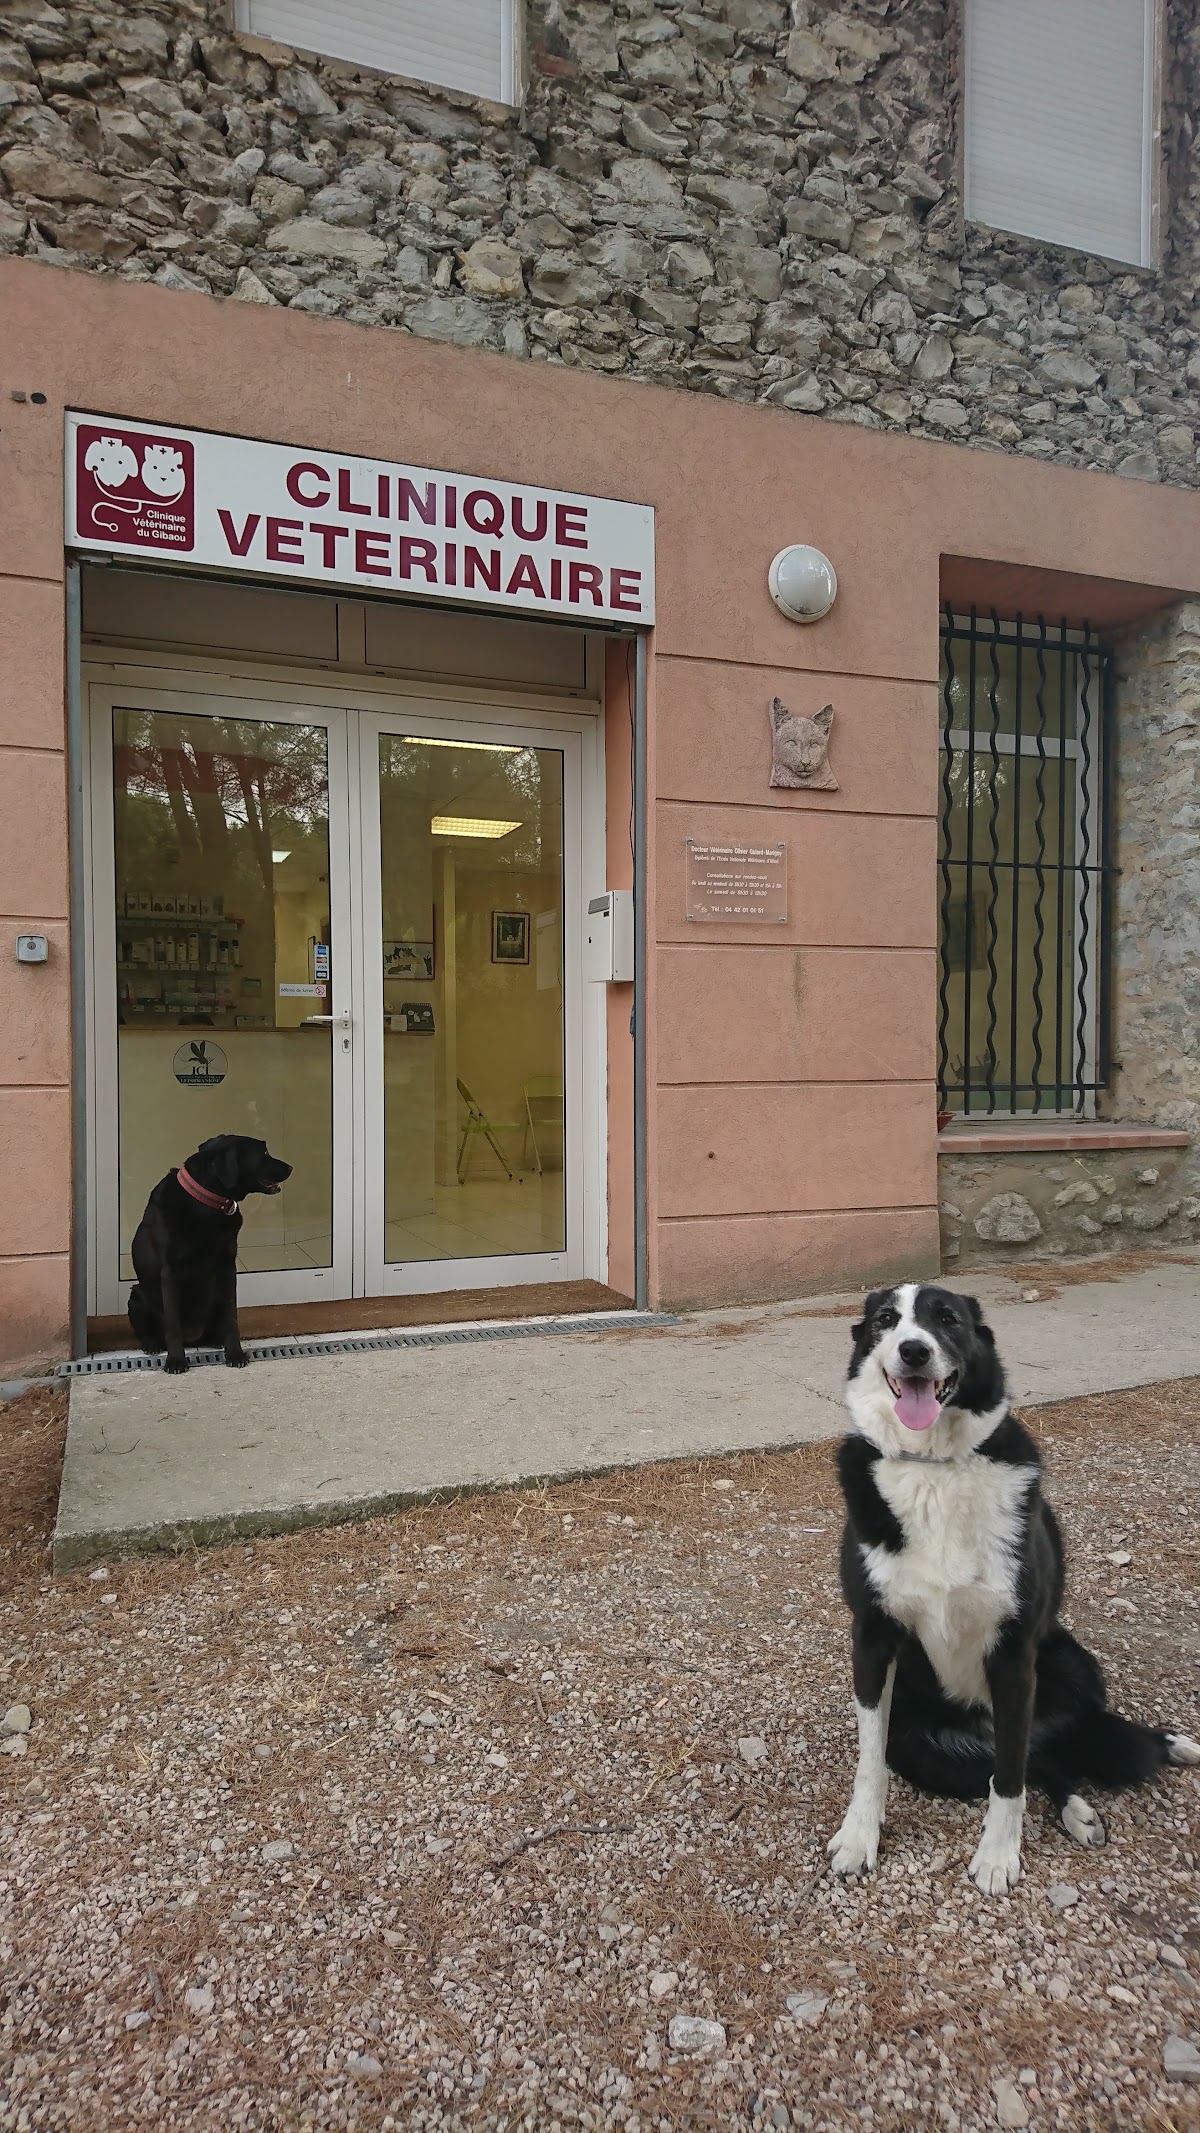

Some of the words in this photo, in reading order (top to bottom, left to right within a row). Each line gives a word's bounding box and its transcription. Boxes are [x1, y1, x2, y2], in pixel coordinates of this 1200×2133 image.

[286, 462, 588, 550] CLINIQUE
[146, 510, 186, 522] Clinique
[132, 517, 186, 532] Vétérinaire
[137, 528, 150, 537] du
[152, 530, 186, 542] Gibaou
[216, 508, 642, 613] VETERINAIRE
[192, 1066, 209, 1075] ICI
